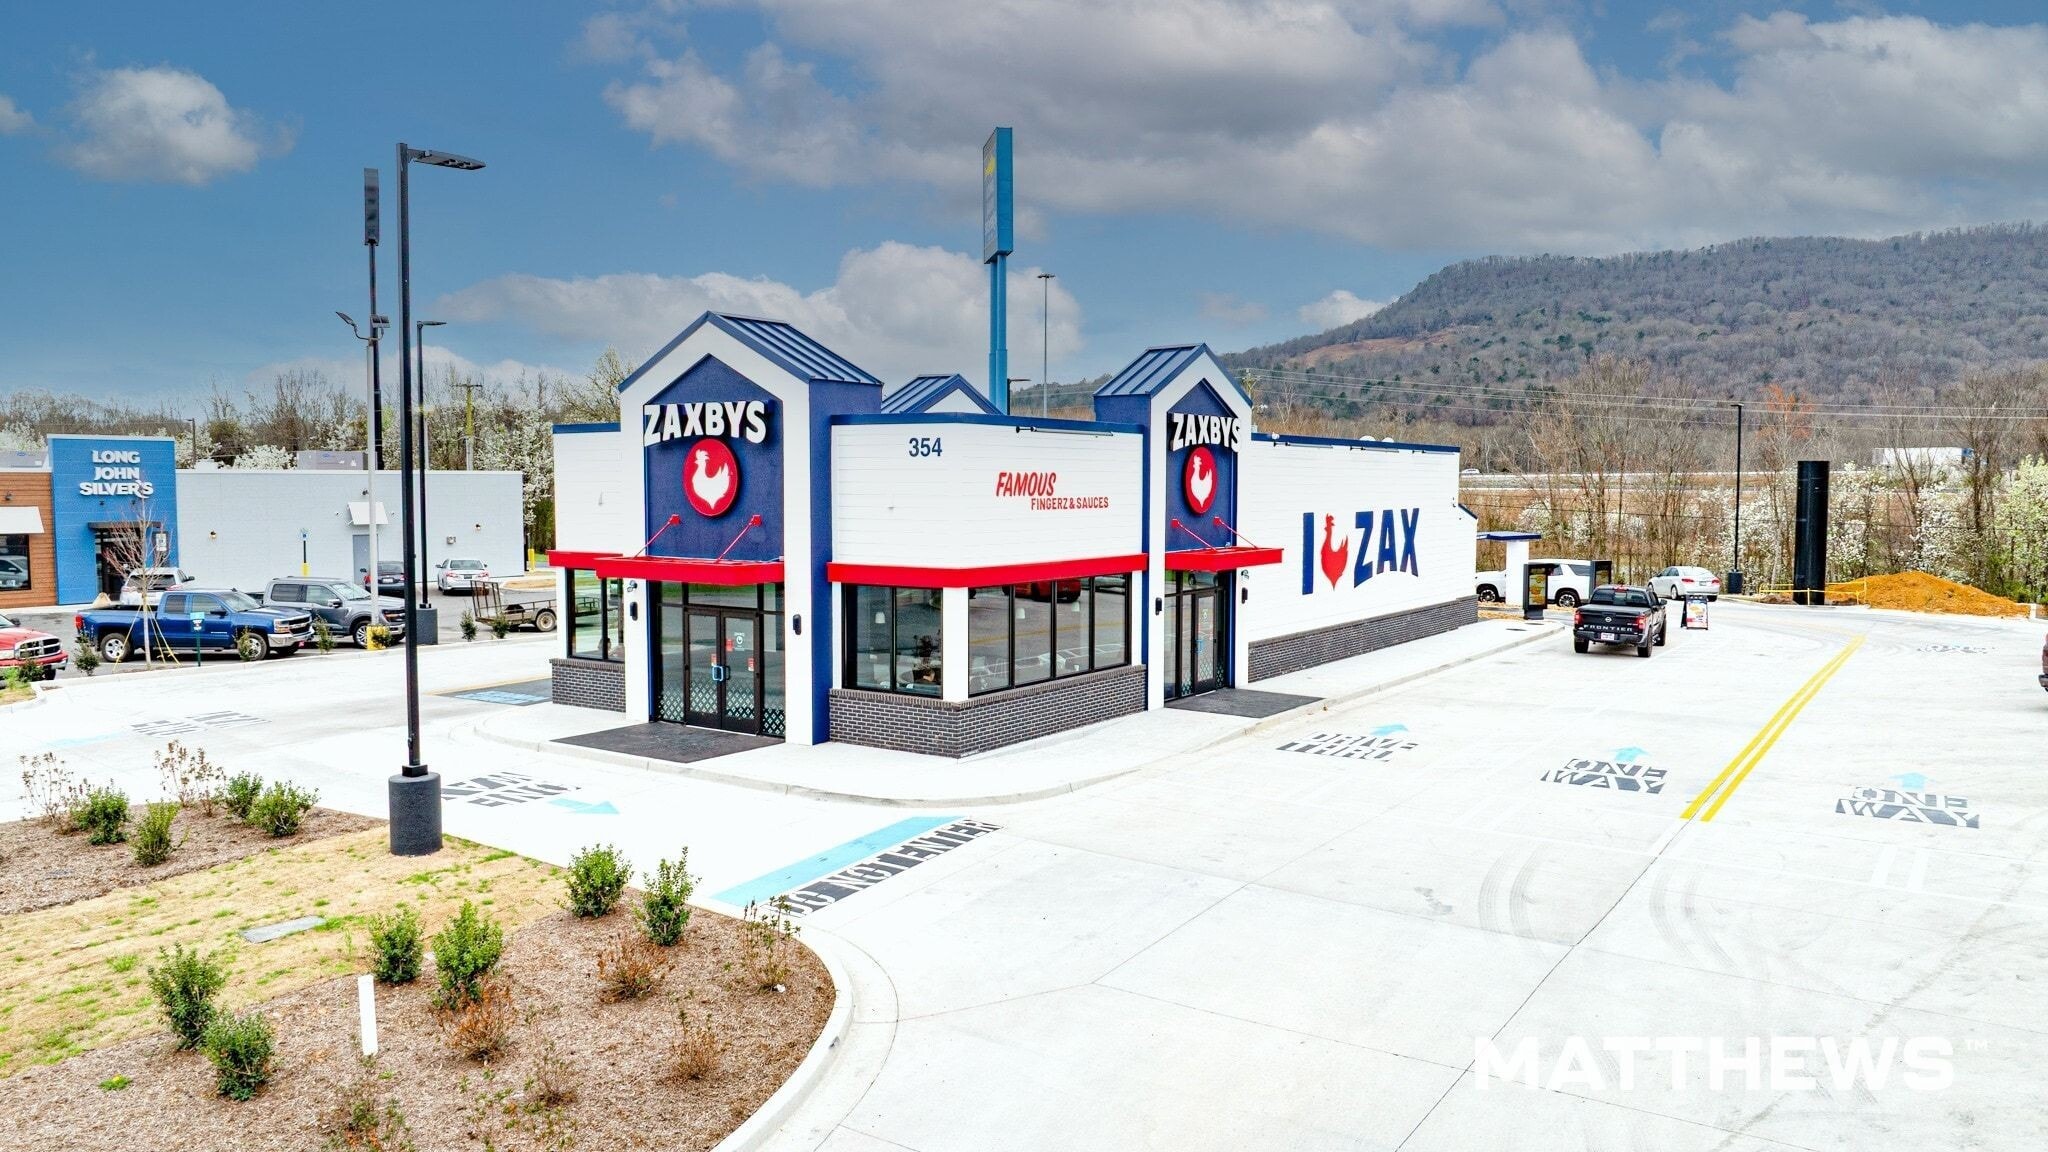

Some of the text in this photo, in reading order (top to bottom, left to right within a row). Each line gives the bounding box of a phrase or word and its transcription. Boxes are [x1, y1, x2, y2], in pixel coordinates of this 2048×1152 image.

[643, 400, 766, 447] ZAXBYS
[1172, 412, 1241, 453] ZAXBYS
[92, 450, 140, 463] LONG
[909, 438, 942, 457] 354
[94, 466, 139, 480] JOHN
[995, 471, 1056, 497] FAMOUS
[79, 480, 154, 498] SILVER'S
[1302, 508, 1420, 595] I ZAX
[1583, 624, 1633, 632] FRONTIER
[1561, 758, 1668, 779] ONE
[1540, 769, 1665, 794] WAY
[1852, 786, 1968, 809] ONE
[1835, 798, 1980, 829] WAY
[820, 852, 902, 892] NOT
[896, 819, 1002, 861] ENTER
